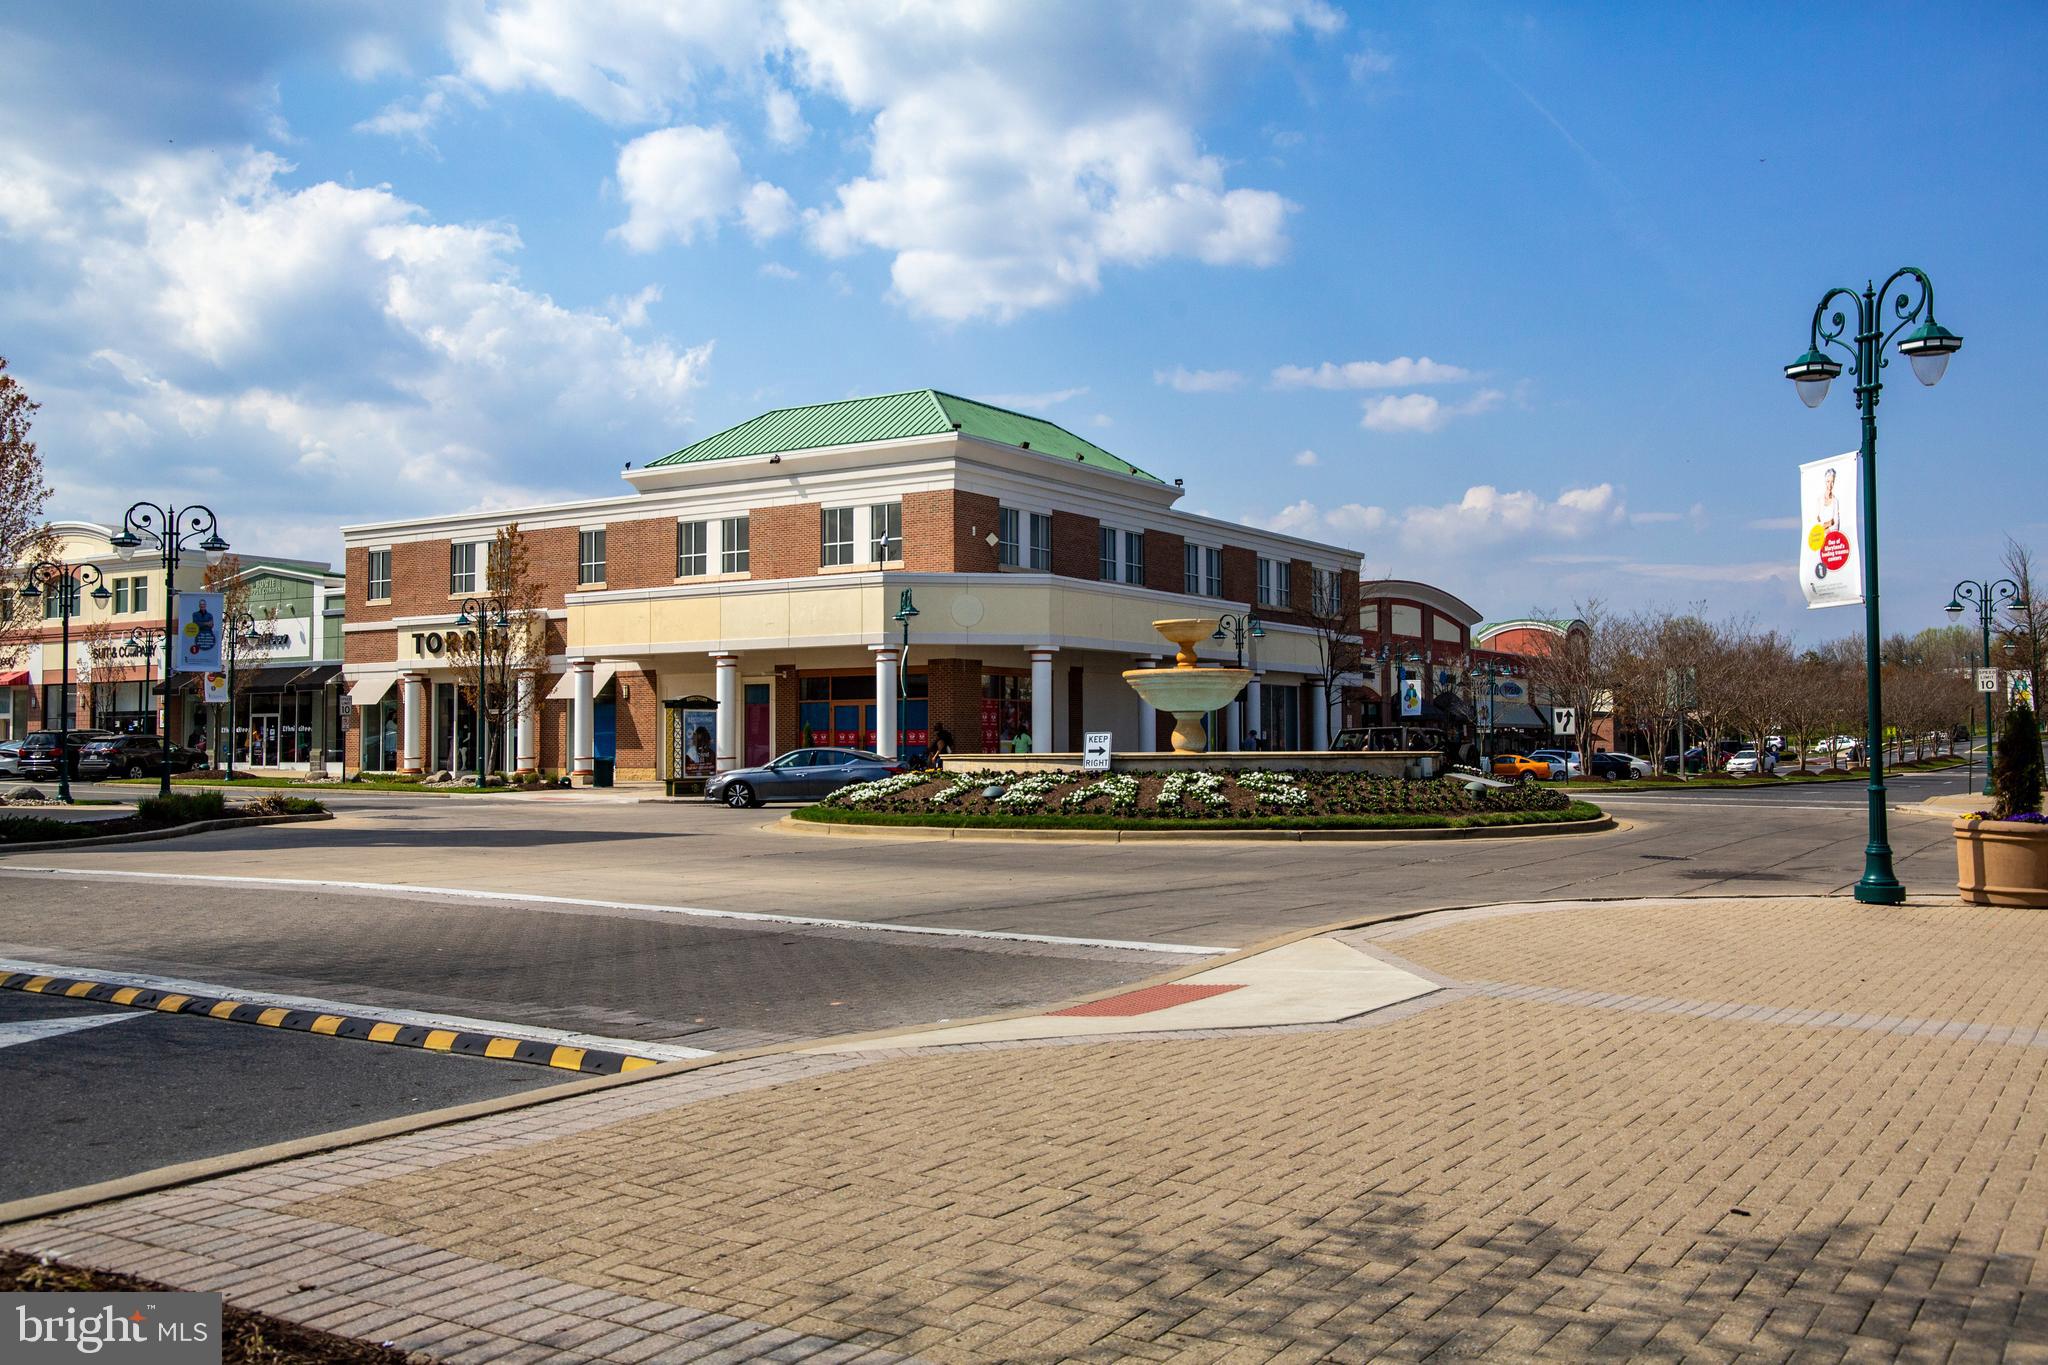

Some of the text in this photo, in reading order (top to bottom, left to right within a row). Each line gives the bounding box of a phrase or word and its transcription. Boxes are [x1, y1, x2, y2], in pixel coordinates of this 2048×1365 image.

[256, 579, 276, 589] BOWIE
[1981, 680, 1994, 690] 10
[341, 705, 350, 714] 10
[1088, 735, 1109, 743] KEEP
